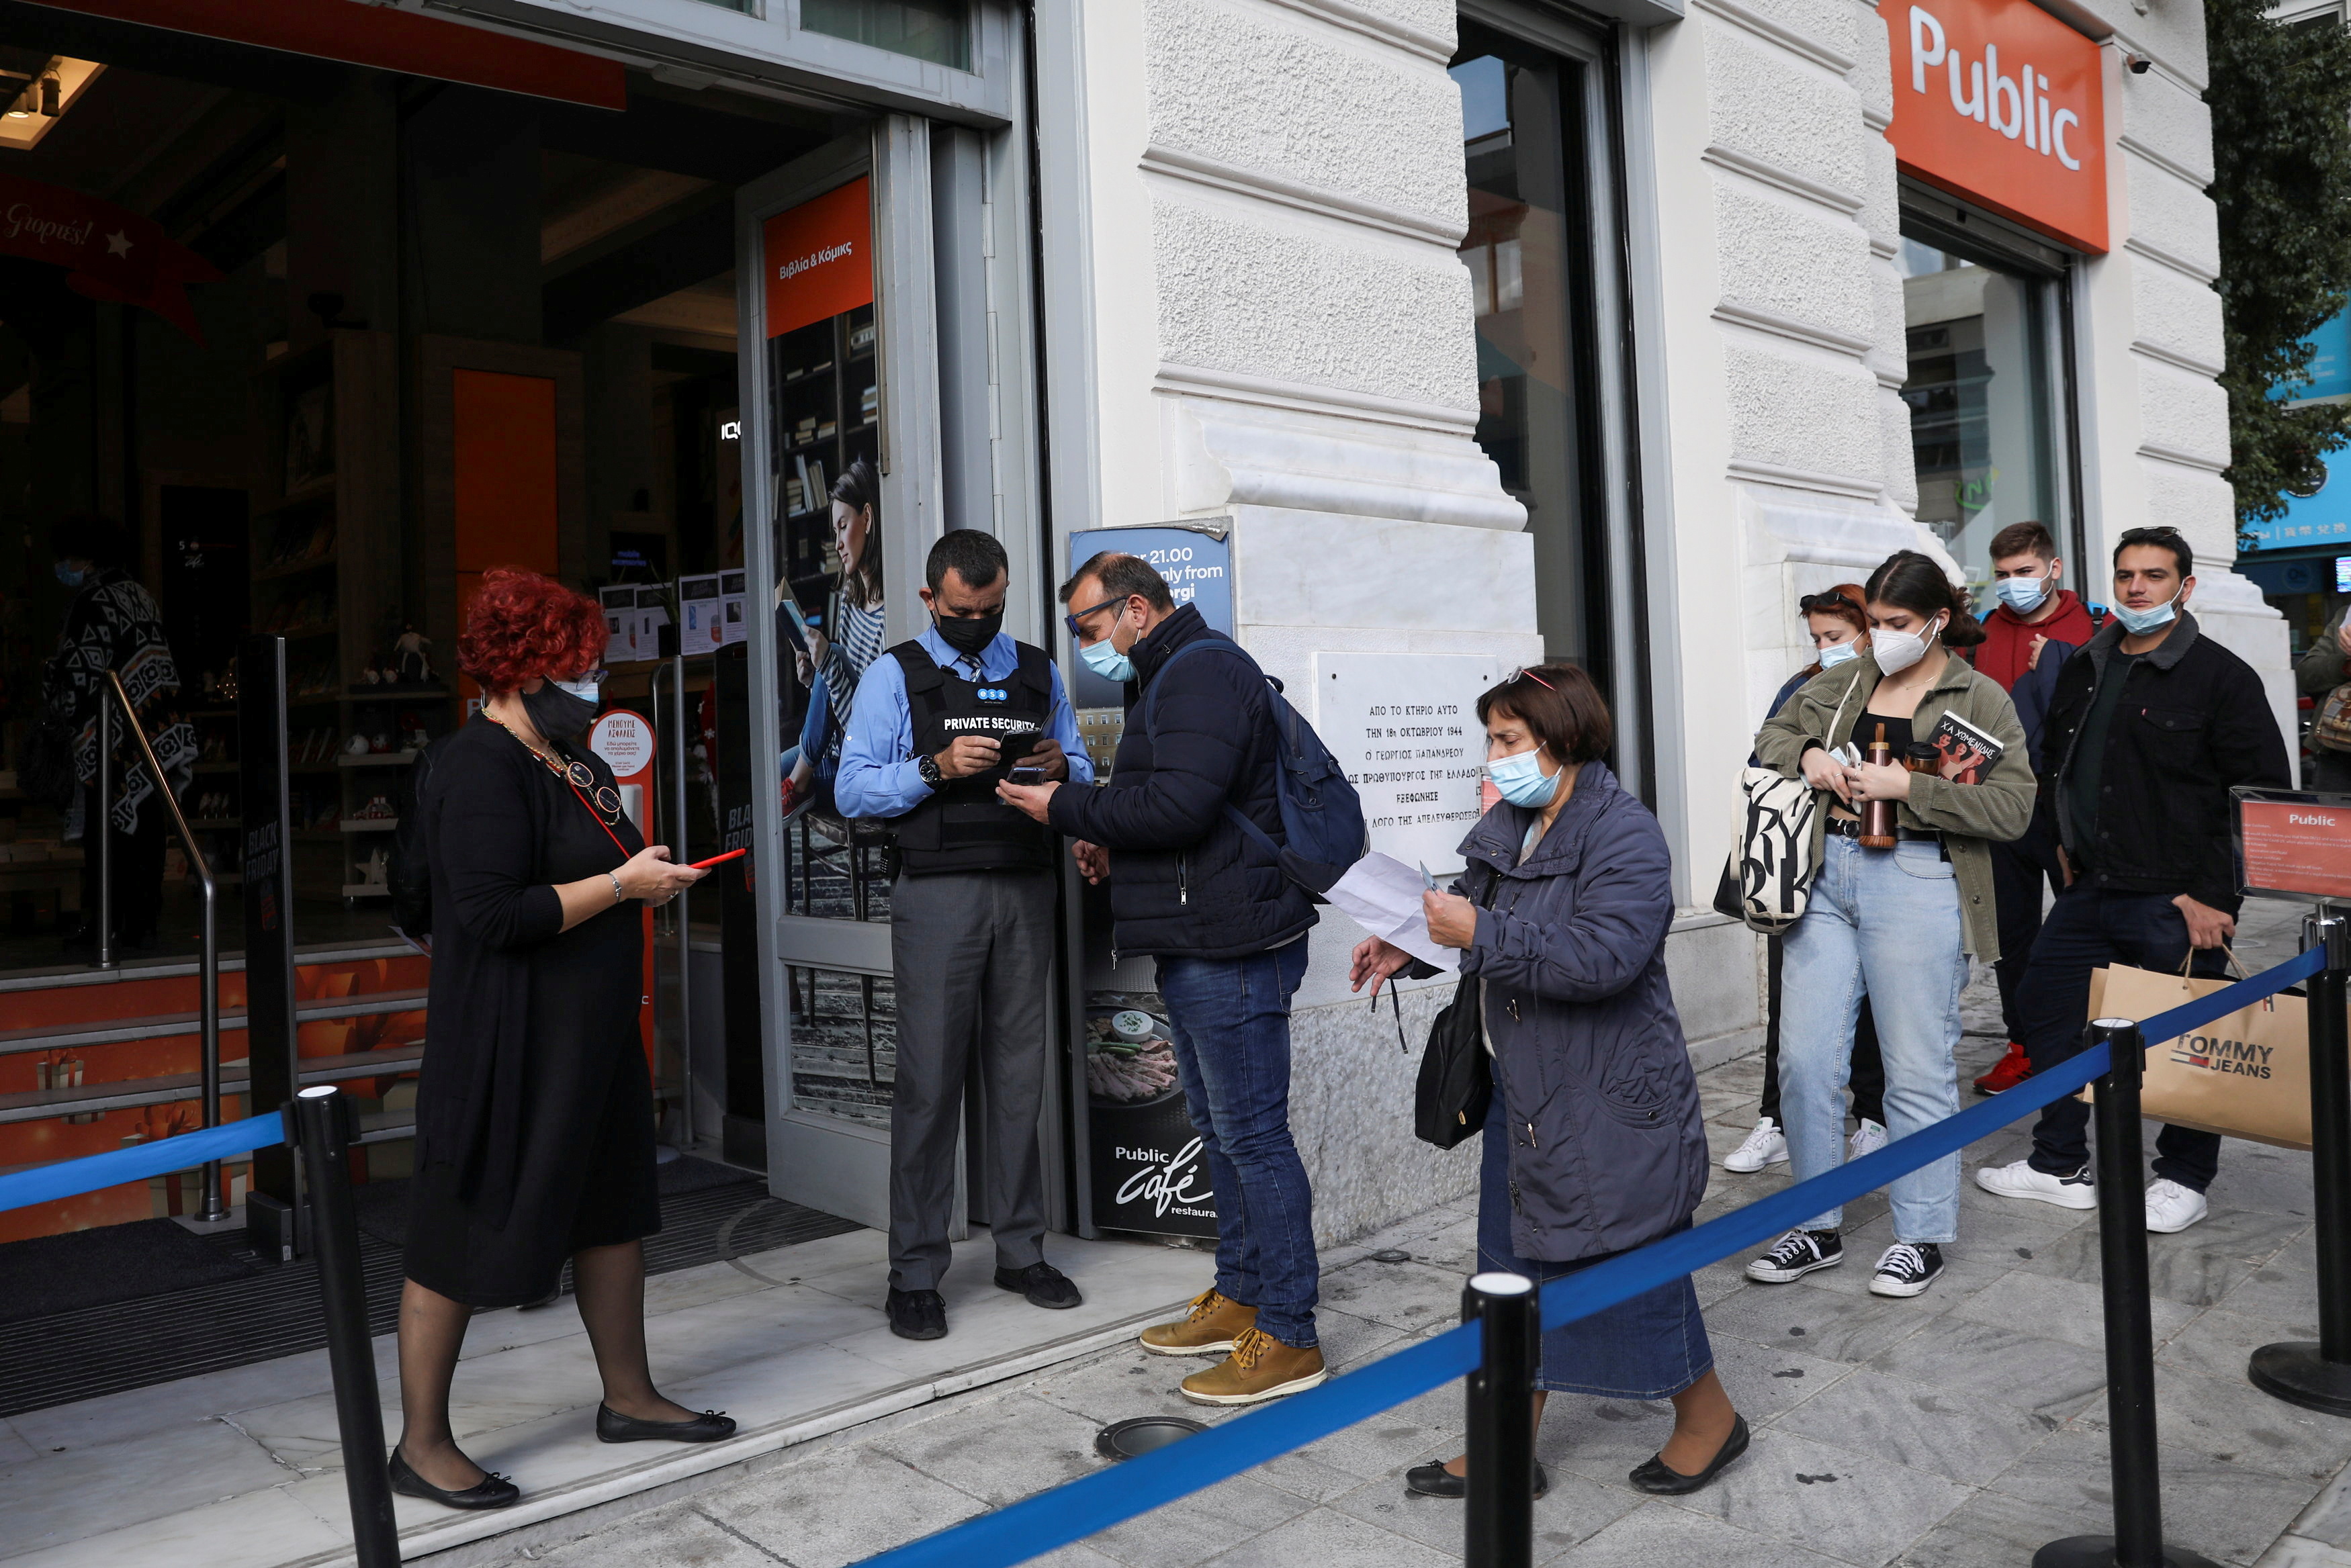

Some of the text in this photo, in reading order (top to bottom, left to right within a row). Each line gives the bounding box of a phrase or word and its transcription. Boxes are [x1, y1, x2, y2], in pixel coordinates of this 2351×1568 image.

[1909, 5, 2080, 171] Public
[779, 241, 852, 280] Βιβλία & Κόμικς
[1149, 547, 1193, 564] 21.00
[1184, 565, 1223, 580] from
[980, 690, 1004, 699] esa
[1369, 704, 1458, 717] ΑΠΟ ΤΟ ΚΤΗΡΙΟ ΑΥΤΟ
[608, 720, 635, 729] ΜΕΝΟΥΜΕ
[944, 718, 1035, 731] PRIVATE SECURITY
[608, 729, 635, 738] ΑΣΦΑΛΕΙΣ
[1366, 727, 1382, 739] ΤΗΝ
[1400, 726, 1444, 738] ΟΚΤΩΒΡΙΟΥ
[1446, 726, 1463, 736] 1944
[1954, 729, 1996, 760] ΧΩΜΕΝΙΔΗΣ
[1376, 749, 1412, 761] ΓΕΩΡΓΙΟΣ
[1415, 747, 1464, 759] ΠΑΠΑΝΔΡΕΟΥ
[1447, 767, 1478, 779] ΕΛΛΑΔΟ
[1396, 791, 1439, 803] ΕΞΕΦΩΝΗΣΕ
[1397, 815, 1413, 826] ΤΗΣ
[2289, 814, 2336, 827] Public
[247, 820, 278, 855] BLACK
[246, 847, 280, 886] FRIDAY
[2210, 1059, 2272, 1080] JEANS
[1116, 1146, 1169, 1163] Public
[1171, 1207, 1218, 1218] restaura
